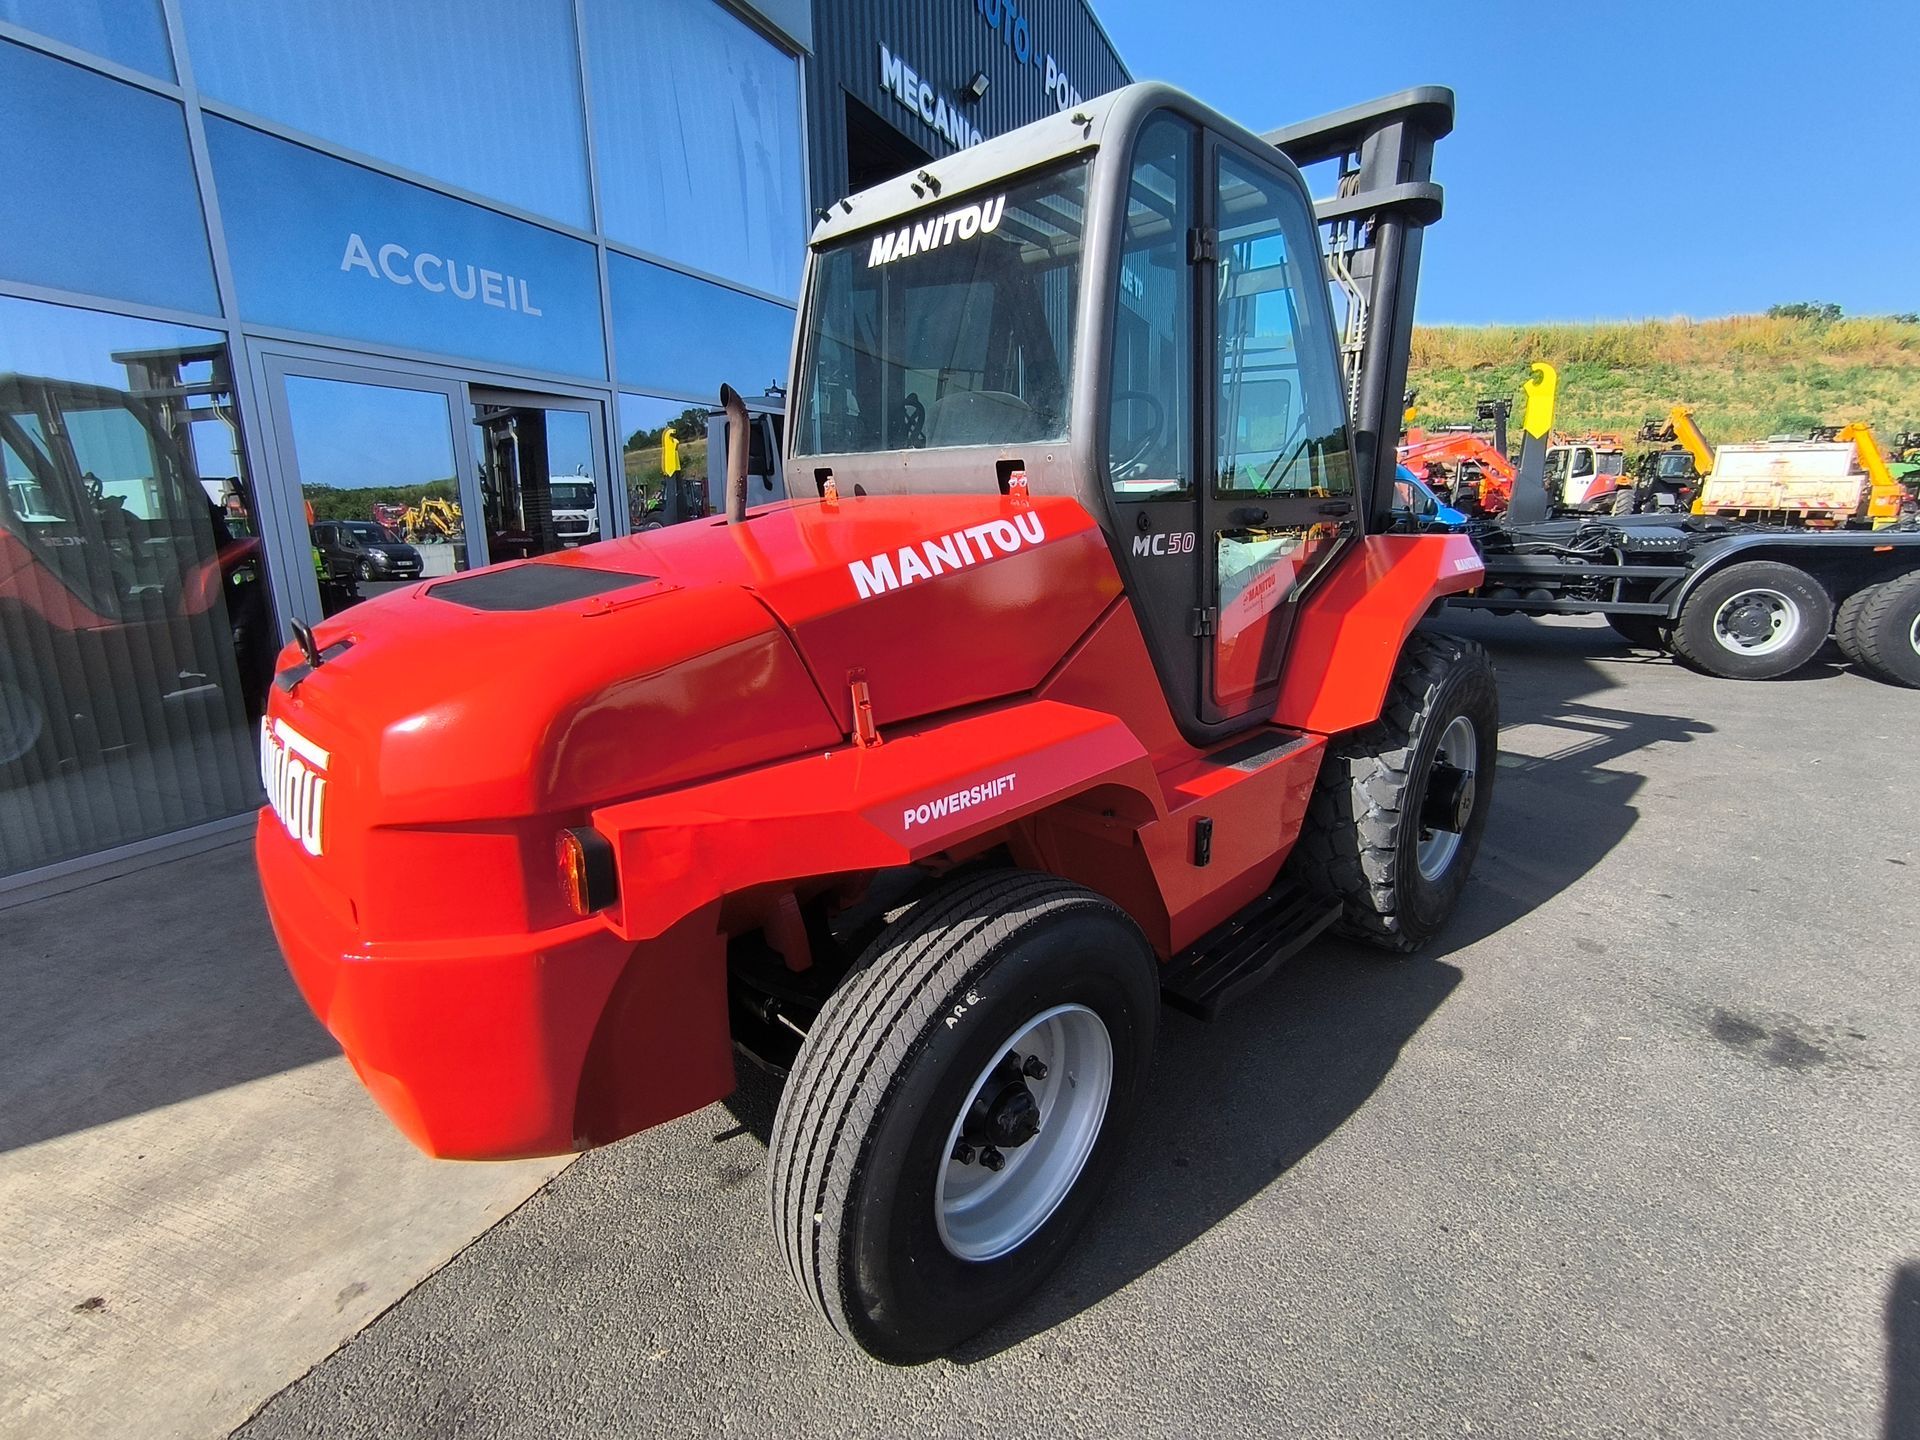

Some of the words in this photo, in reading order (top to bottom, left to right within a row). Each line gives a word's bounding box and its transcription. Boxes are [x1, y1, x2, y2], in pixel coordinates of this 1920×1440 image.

[977, 0, 1031, 64] UTO
[880, 45, 987, 152] MECANI
[867, 194, 1006, 268] MANITOU
[340, 233, 543, 317] ACCUEIL
[848, 511, 1045, 600] MANITOU
[903, 773, 1016, 830] POWERSHIFT
